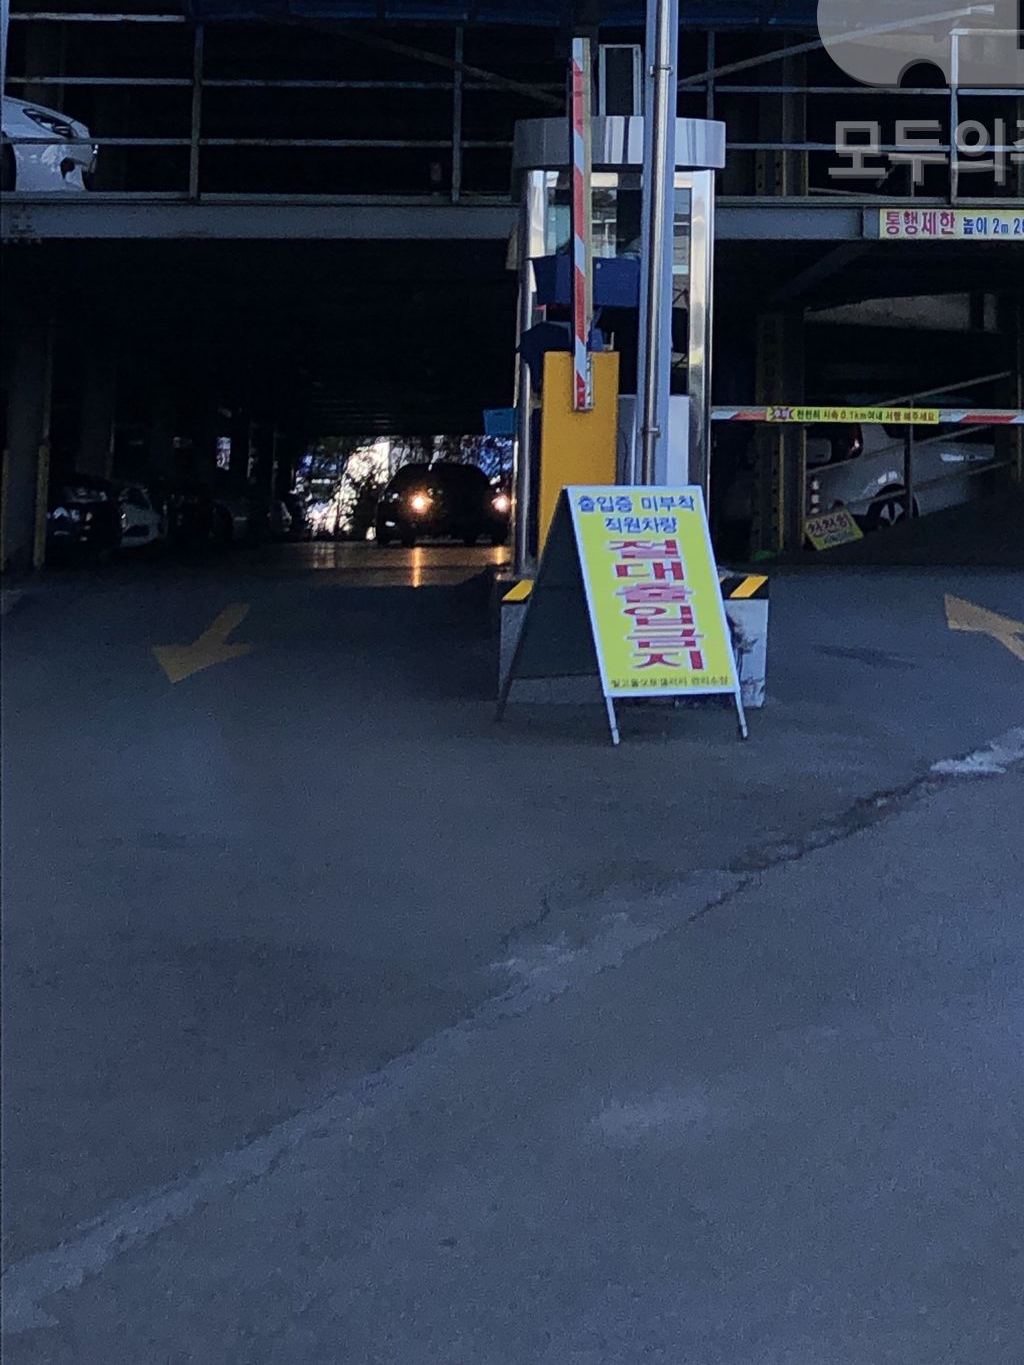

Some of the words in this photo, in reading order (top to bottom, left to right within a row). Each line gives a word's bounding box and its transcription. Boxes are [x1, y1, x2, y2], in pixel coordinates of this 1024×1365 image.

[886, 211, 956, 236] 통행제한
[963, 217, 988, 235] 높이
[578, 495, 633, 513] 출입증
[641, 495, 695, 512] 미부착
[605, 516, 678, 534] 직원차량
